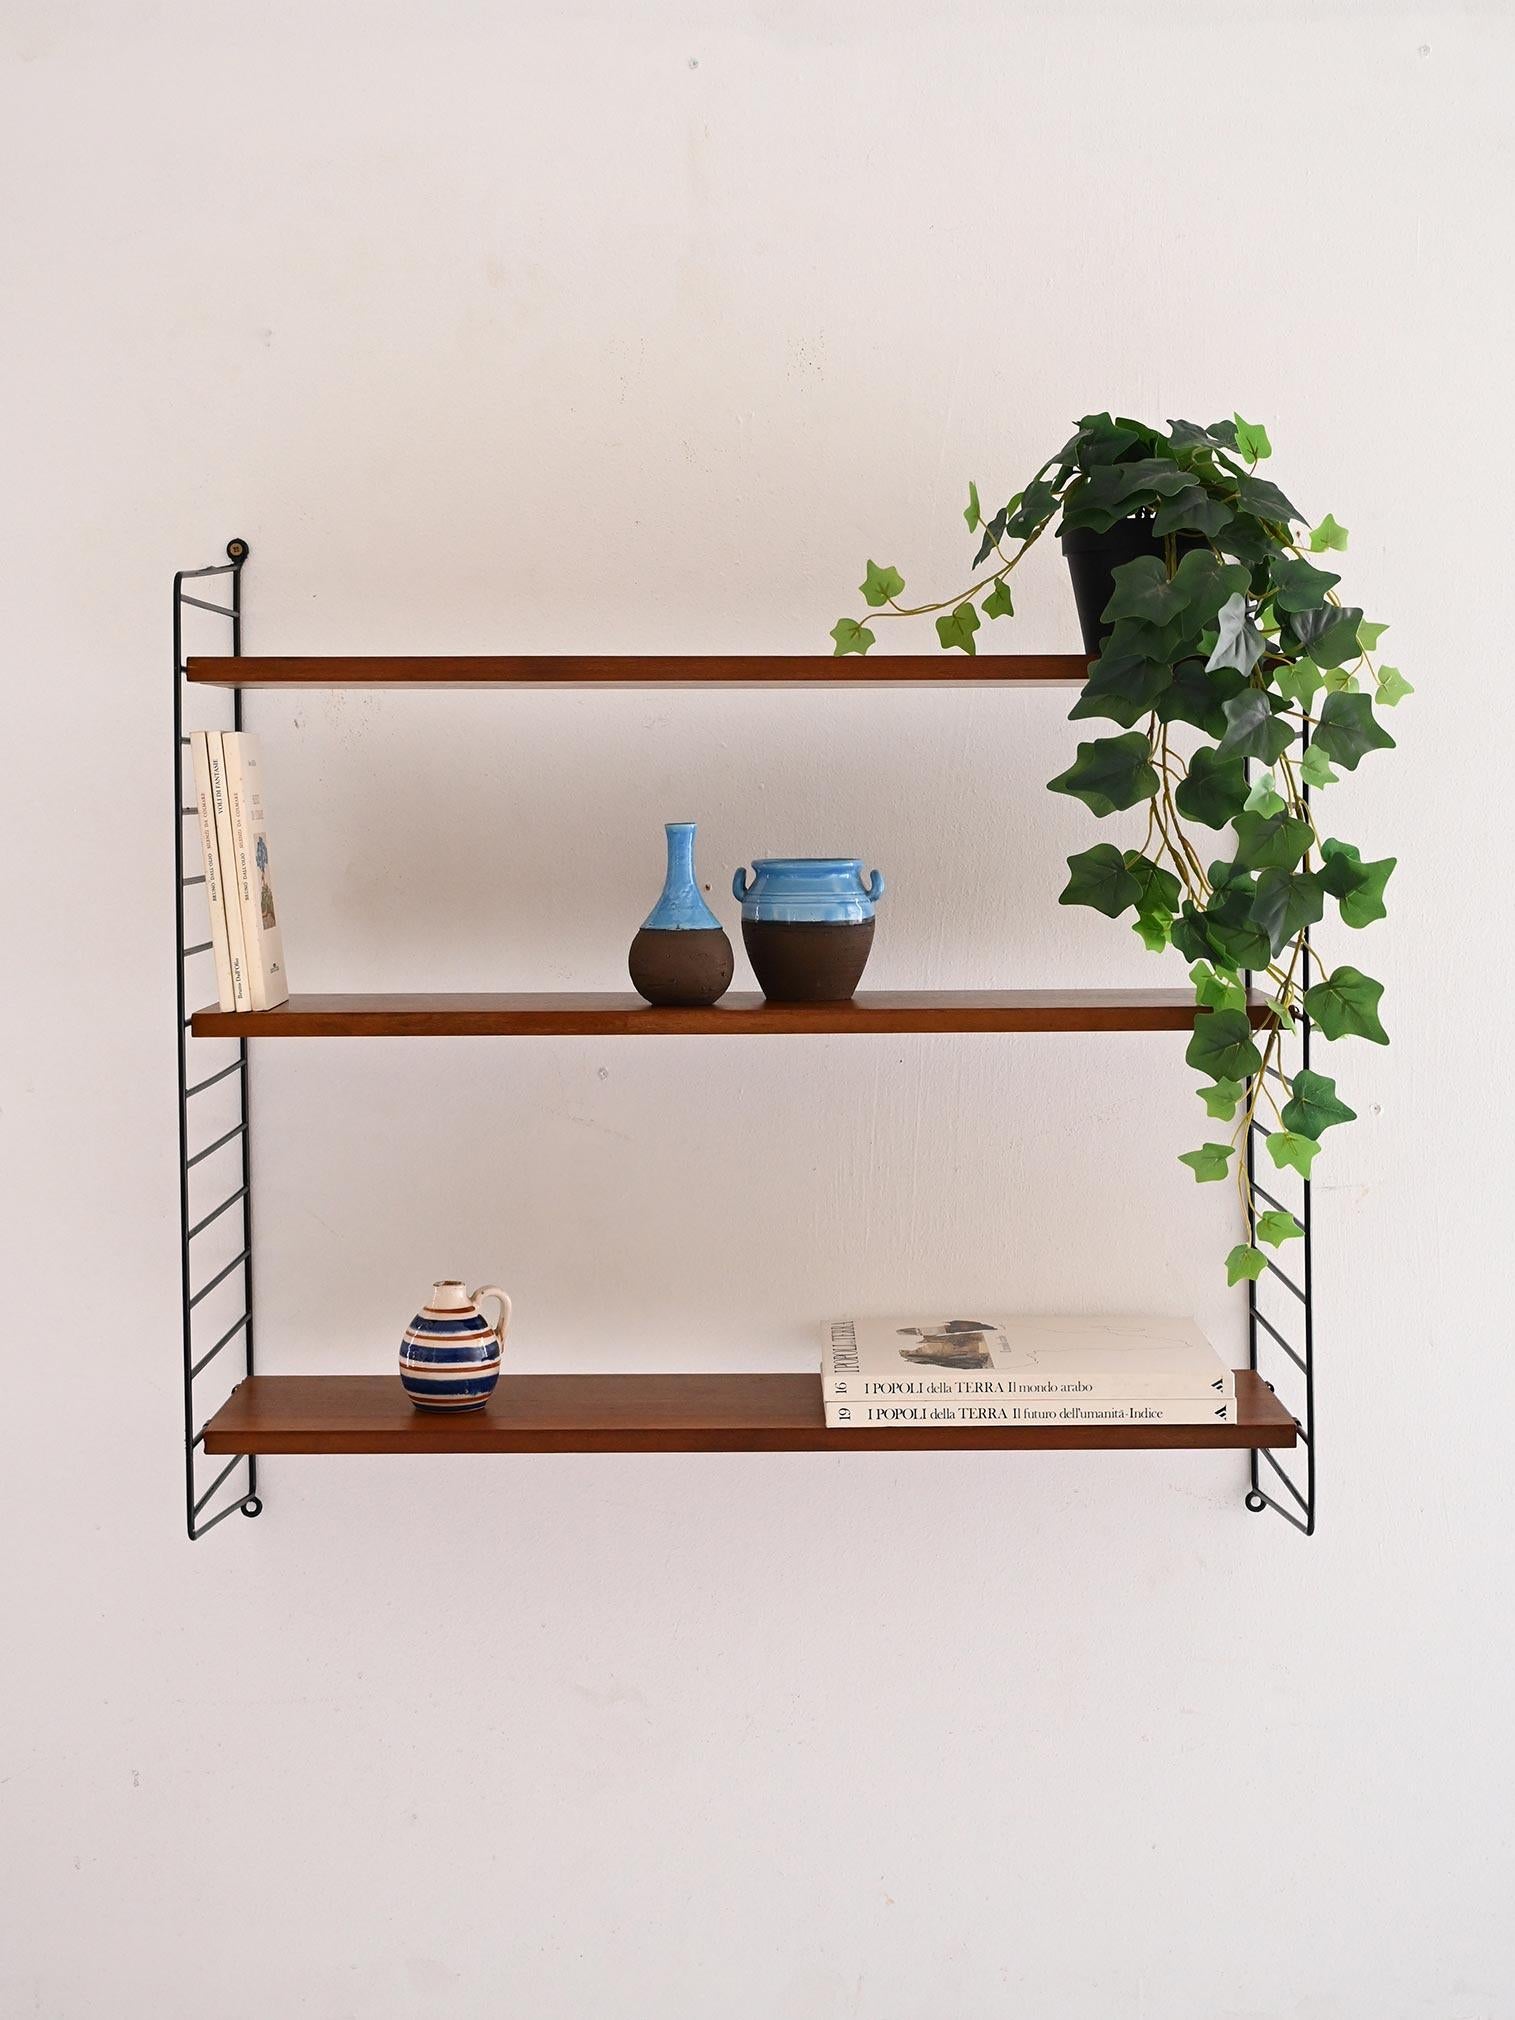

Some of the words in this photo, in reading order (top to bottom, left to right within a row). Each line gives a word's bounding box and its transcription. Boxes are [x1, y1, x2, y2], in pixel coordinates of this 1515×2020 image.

[213, 759, 221, 789] FANTASIE
[215, 788, 222, 798] DI
[835, 1381, 847, 1394] 16
[865, 1383, 869, 1394] I
[873, 1382, 923, 1394] POPOLI
[926, 1382, 952, 1394] della
[955, 1382, 1004, 1393] TERRA
[1008, 1381, 1017, 1393] Il
[1019, 1381, 1058, 1393] mondo
[1060, 1381, 1093, 1392] arabo
[838, 1407, 851, 1420] 19
[868, 1408, 873, 1420] I
[876, 1408, 927, 1420] POPOLI
[930, 1408, 956, 1420] della
[958, 1408, 1008, 1420] TERRA
[1013, 1407, 1021, 1419] Il
[1023, 1407, 1057, 1419] futuro
